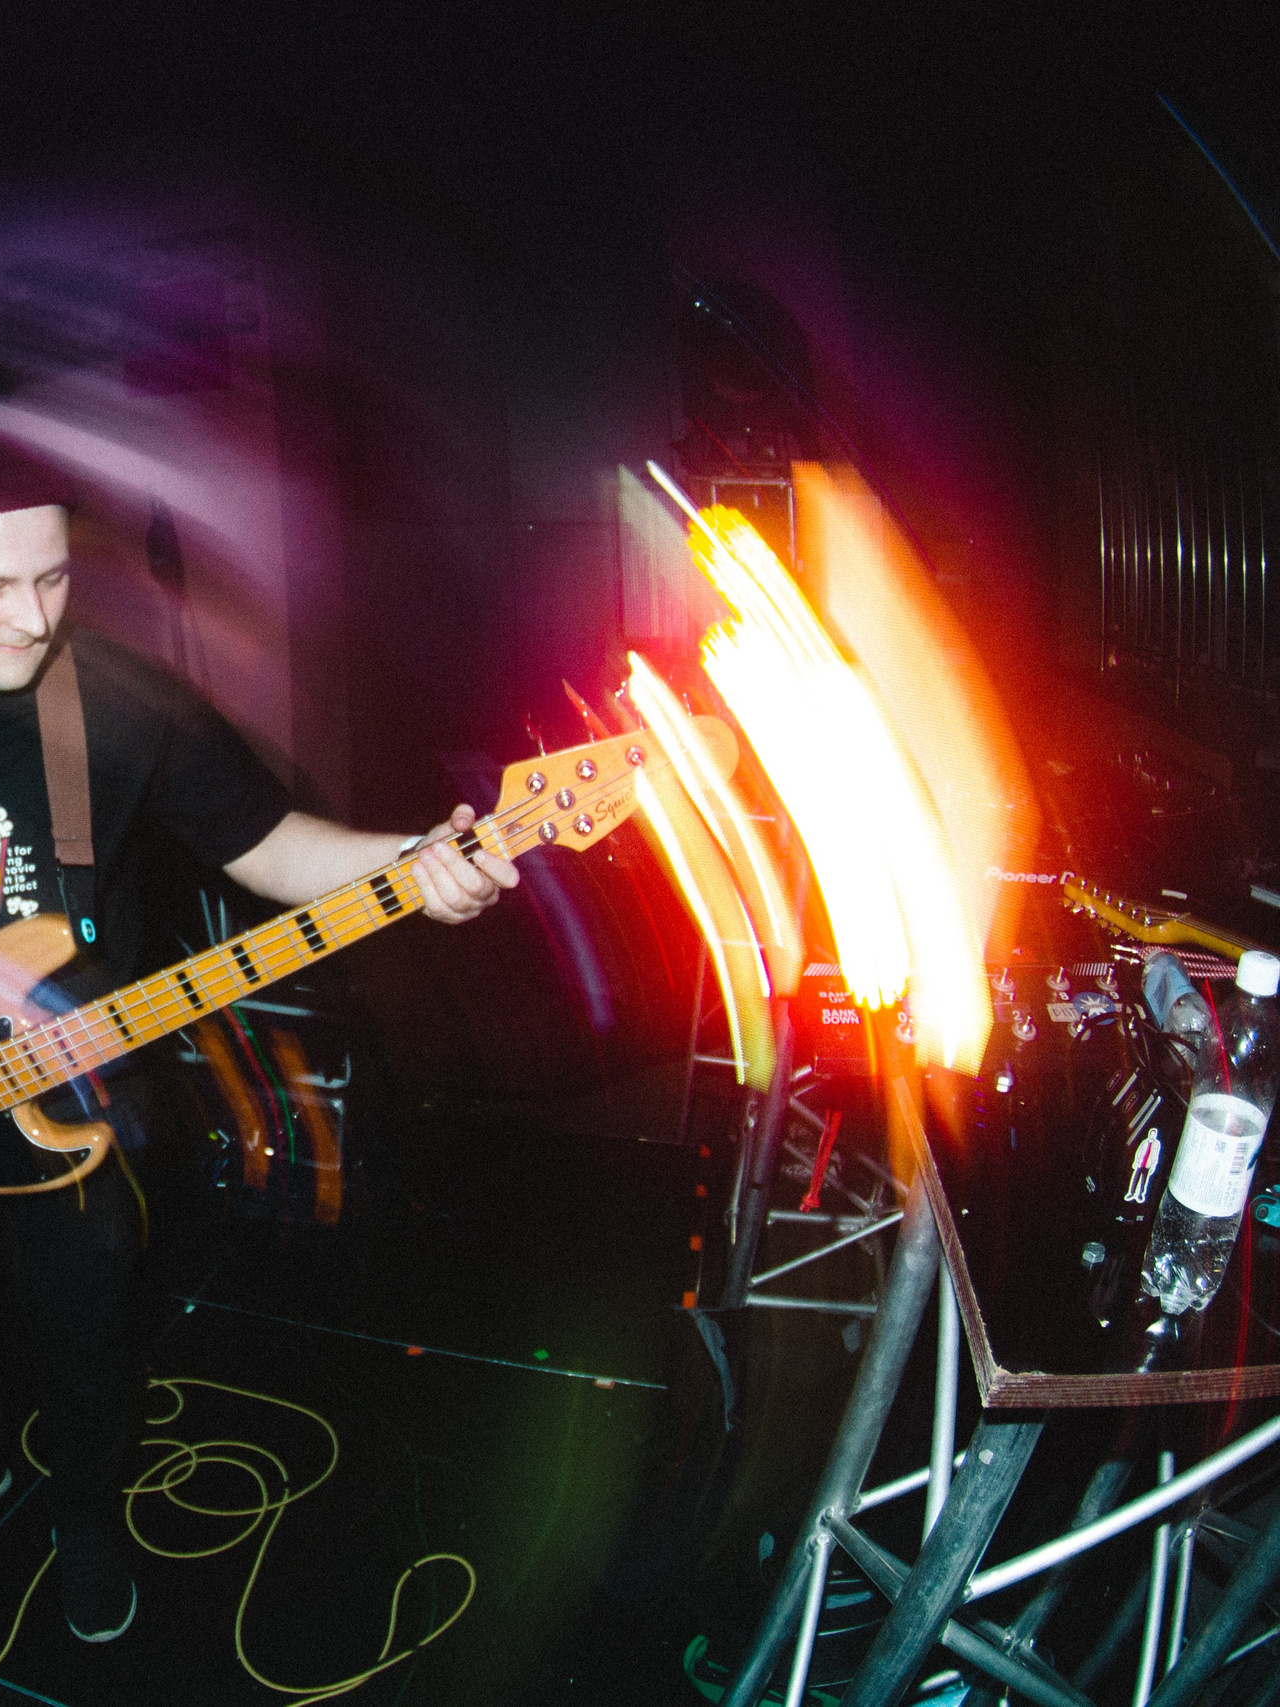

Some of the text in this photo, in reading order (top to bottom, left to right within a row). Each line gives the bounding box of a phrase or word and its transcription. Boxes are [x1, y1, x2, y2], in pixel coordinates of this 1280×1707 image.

[14, 845, 32, 857] for
[14, 874, 26, 884] is
[983, 866, 1058, 884] Pioneer
[1059, 991, 1070, 1001] 8
[822, 1008, 857, 1017] BANK
[822, 1016, 861, 1025] DOWN
